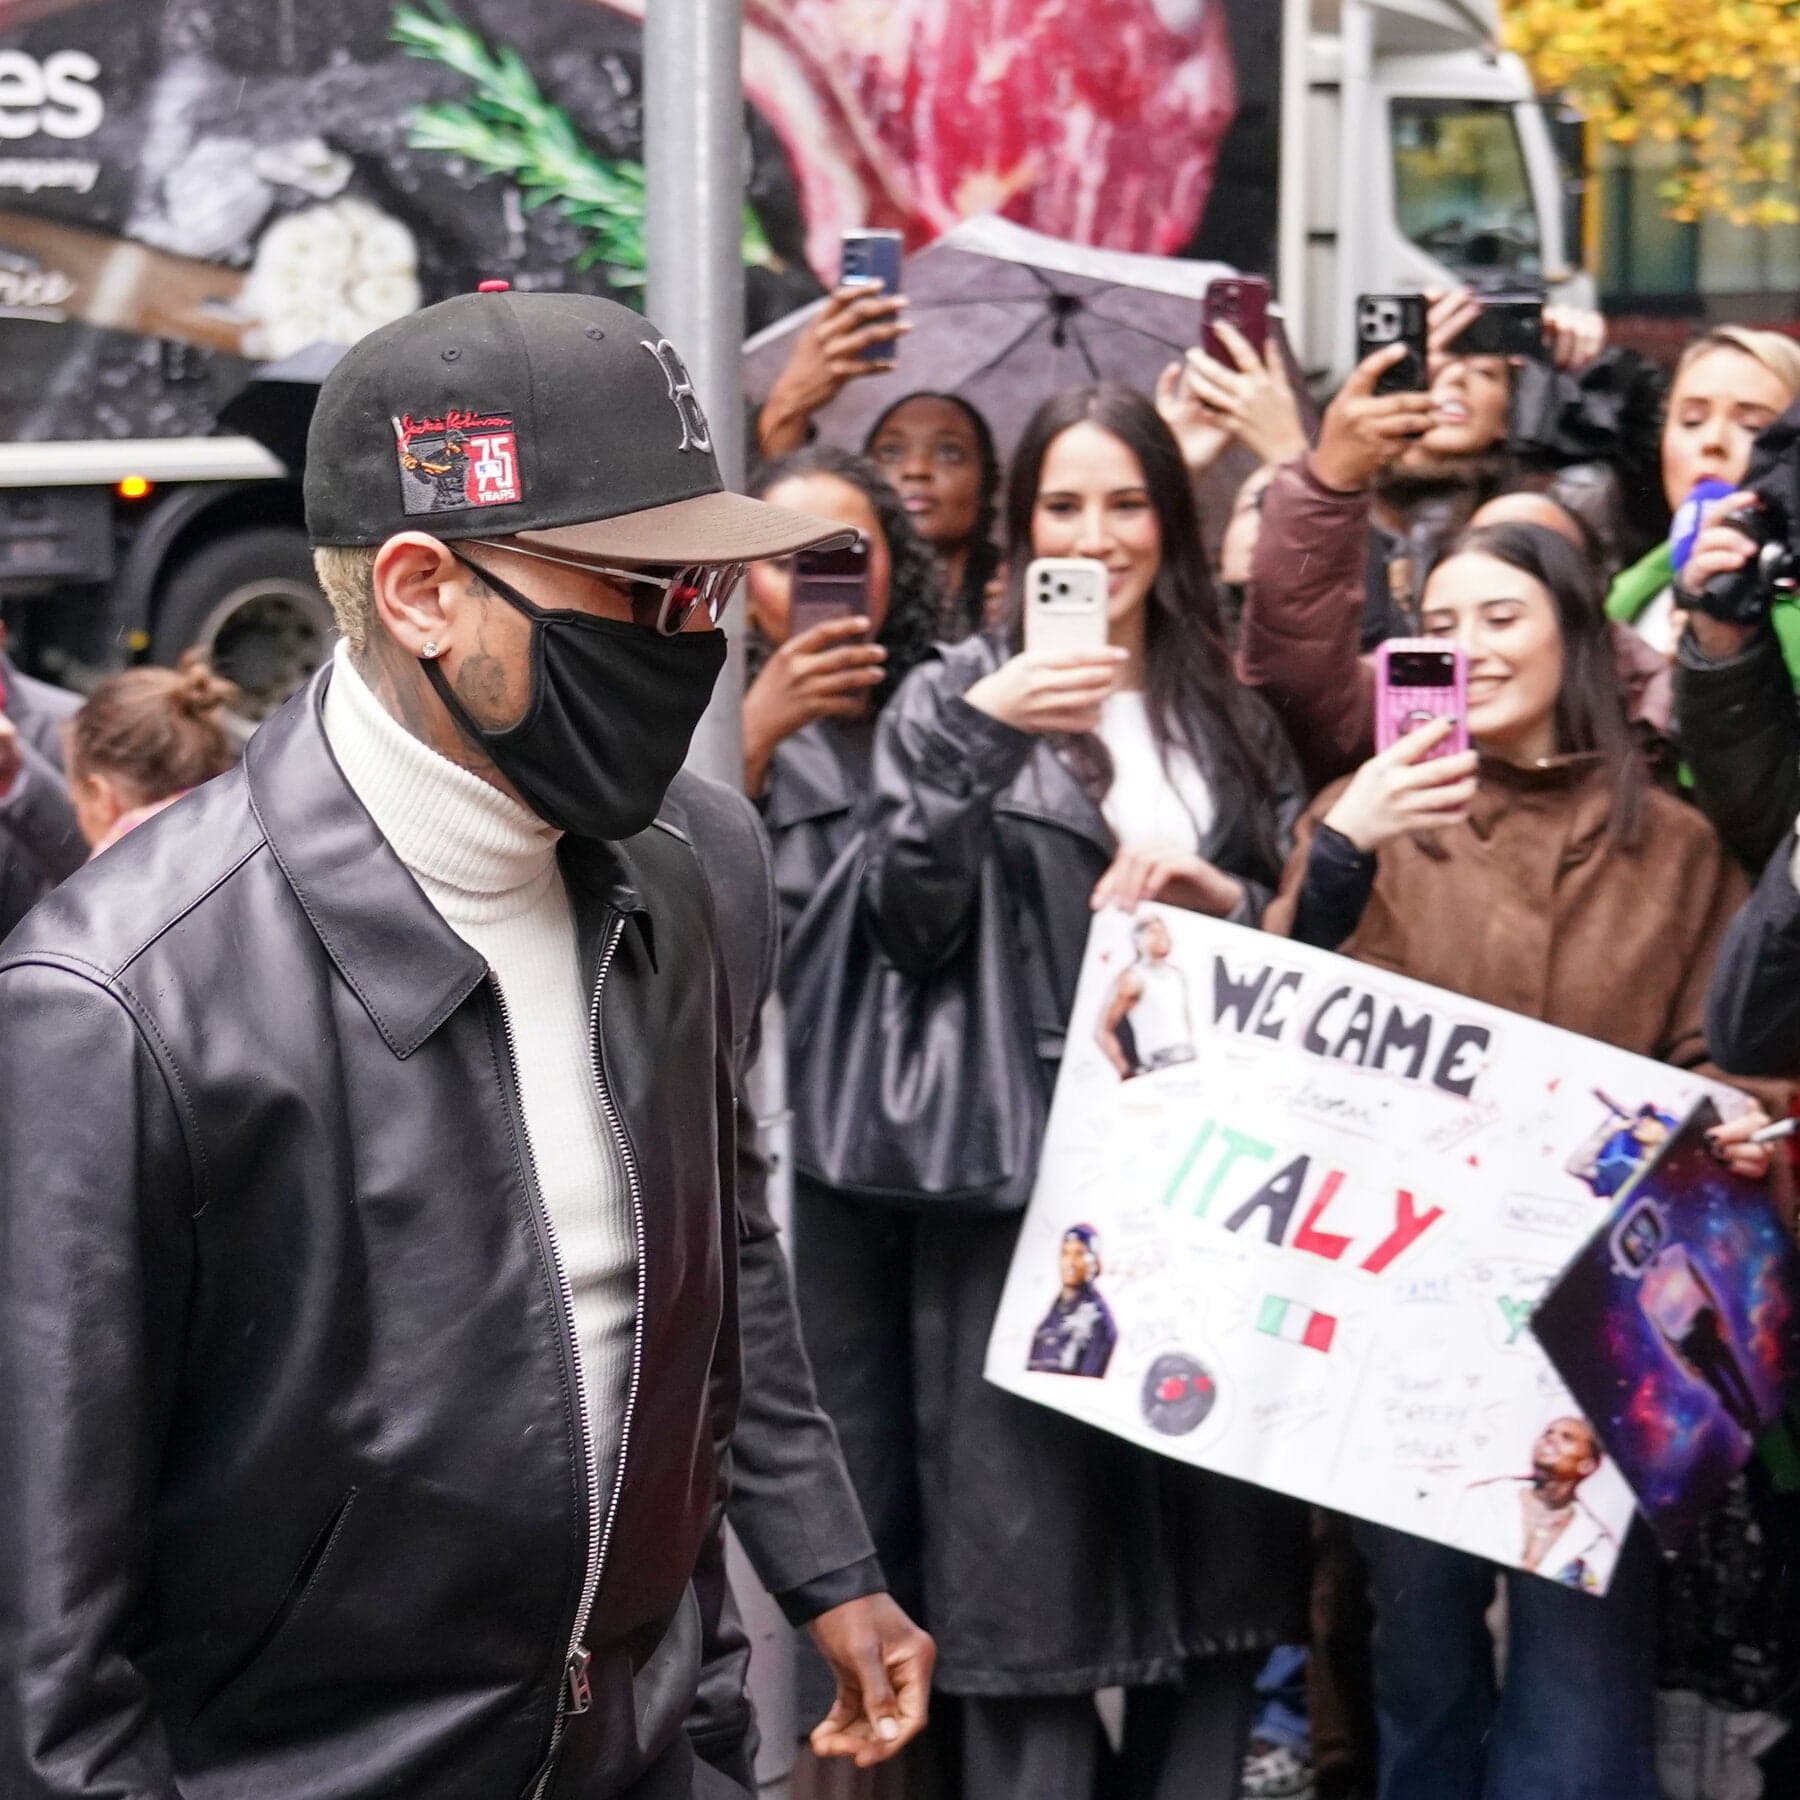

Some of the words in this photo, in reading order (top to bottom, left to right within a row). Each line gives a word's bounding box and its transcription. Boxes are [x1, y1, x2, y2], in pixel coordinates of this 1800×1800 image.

[447, 409, 513, 430] Robinson
[470, 436, 514, 492] 75
[477, 488, 516, 502] YEARS
[1211, 954, 1304, 1042] WE
[1303, 984, 1491, 1097] CAME
[1160, 1117, 1445, 1275] ITALY
